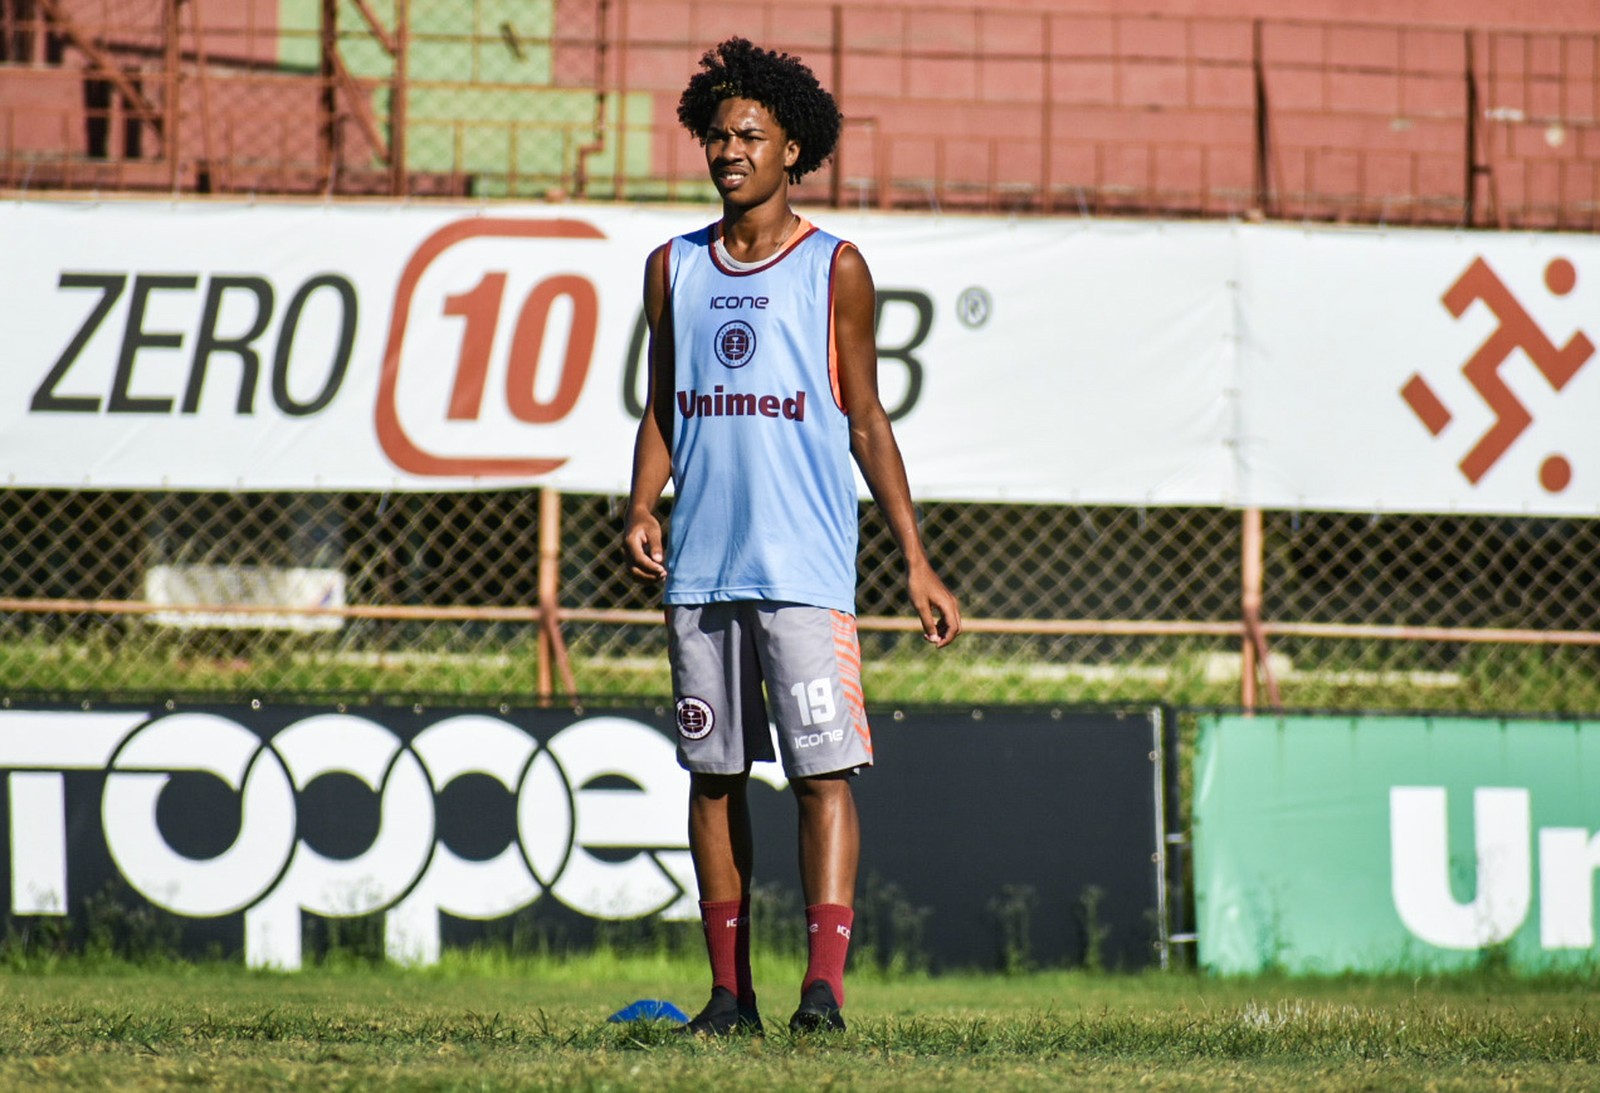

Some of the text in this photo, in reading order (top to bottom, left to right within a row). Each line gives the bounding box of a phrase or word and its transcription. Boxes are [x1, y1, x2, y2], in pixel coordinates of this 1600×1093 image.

[29, 272, 358, 416] ZERO
[443, 271, 599, 424] 10
[678, 386, 805, 421] Unimed
[791, 678, 834, 726] 19
